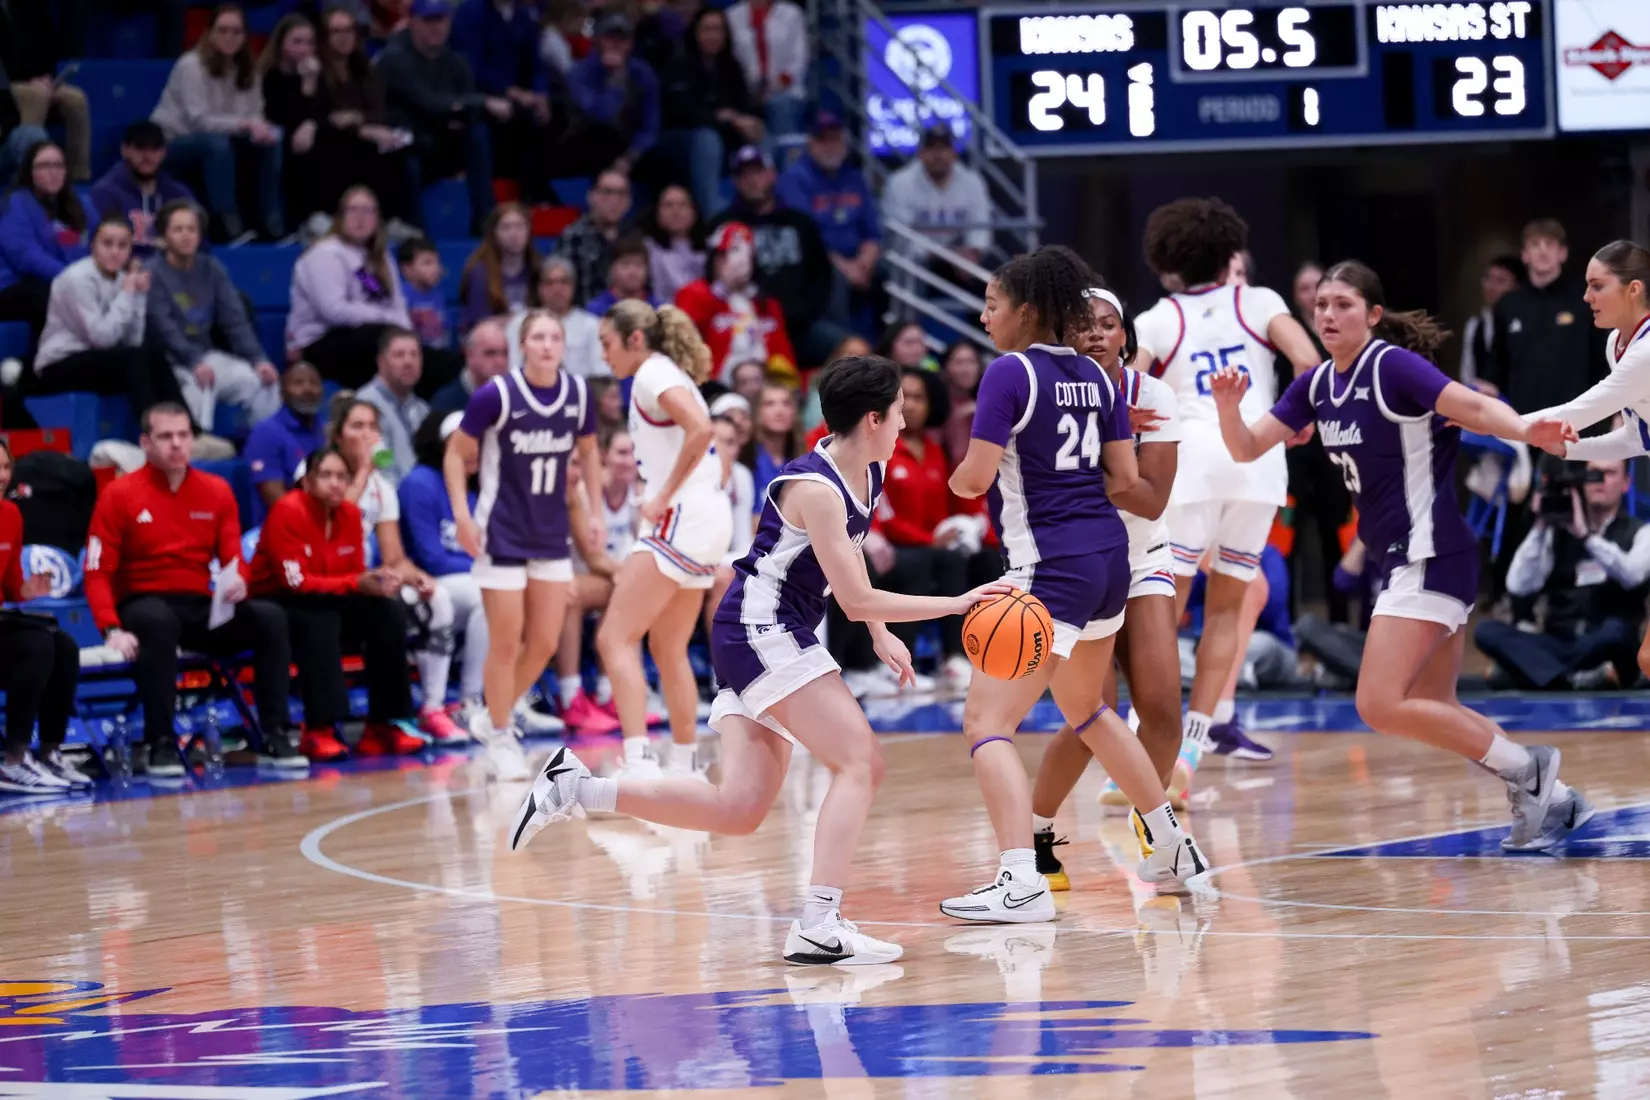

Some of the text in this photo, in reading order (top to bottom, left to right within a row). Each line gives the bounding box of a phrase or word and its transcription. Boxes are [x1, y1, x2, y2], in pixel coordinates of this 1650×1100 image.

[1183, 8, 1315, 70] 05.5
[1376, 1, 1531, 42] KANSAS ST
[1028, 71, 1106, 131] 24
[1198, 94, 1280, 122] PERIOD
[1452, 56, 1525, 116] 23
[1191, 344, 1252, 395] 25
[1055, 381, 1102, 407] COTTON
[510, 429, 574, 454] Wildcat
[1055, 411, 1101, 471] 24
[531, 457, 557, 495] 11
